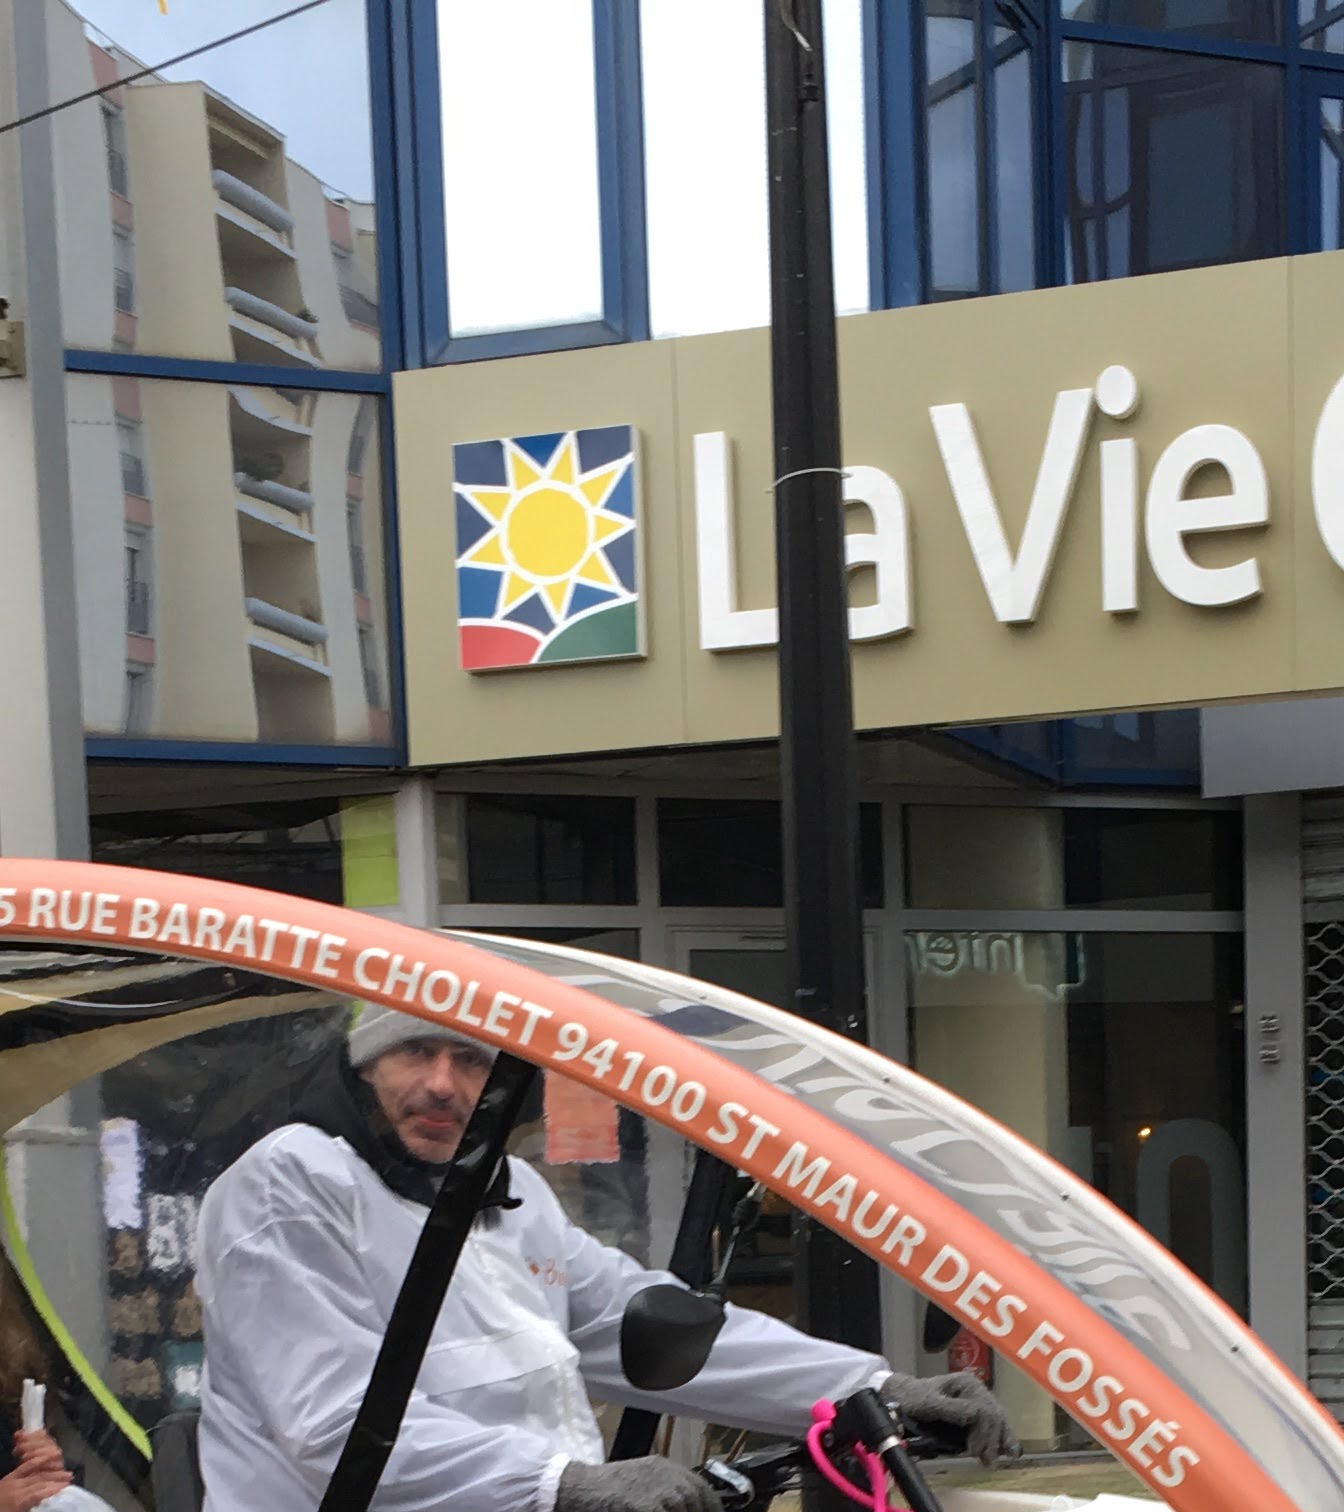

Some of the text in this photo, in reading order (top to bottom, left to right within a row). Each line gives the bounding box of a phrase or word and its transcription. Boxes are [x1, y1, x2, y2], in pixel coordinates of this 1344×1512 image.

[693, 431, 916, 653] La
[928, 365, 1271, 626] Vie
[28, 887, 119, 936] RUE
[128, 896, 347, 980] BARATTE
[351, 947, 554, 1047] CHOLET
[552, 1019, 707, 1124] 94100
[706, 1100, 783, 1160] ST
[775, 1141, 928, 1268] MAUR
[921, 1243, 1029, 1340] DES
[1018, 1325, 1202, 1491] FOSSÉS
